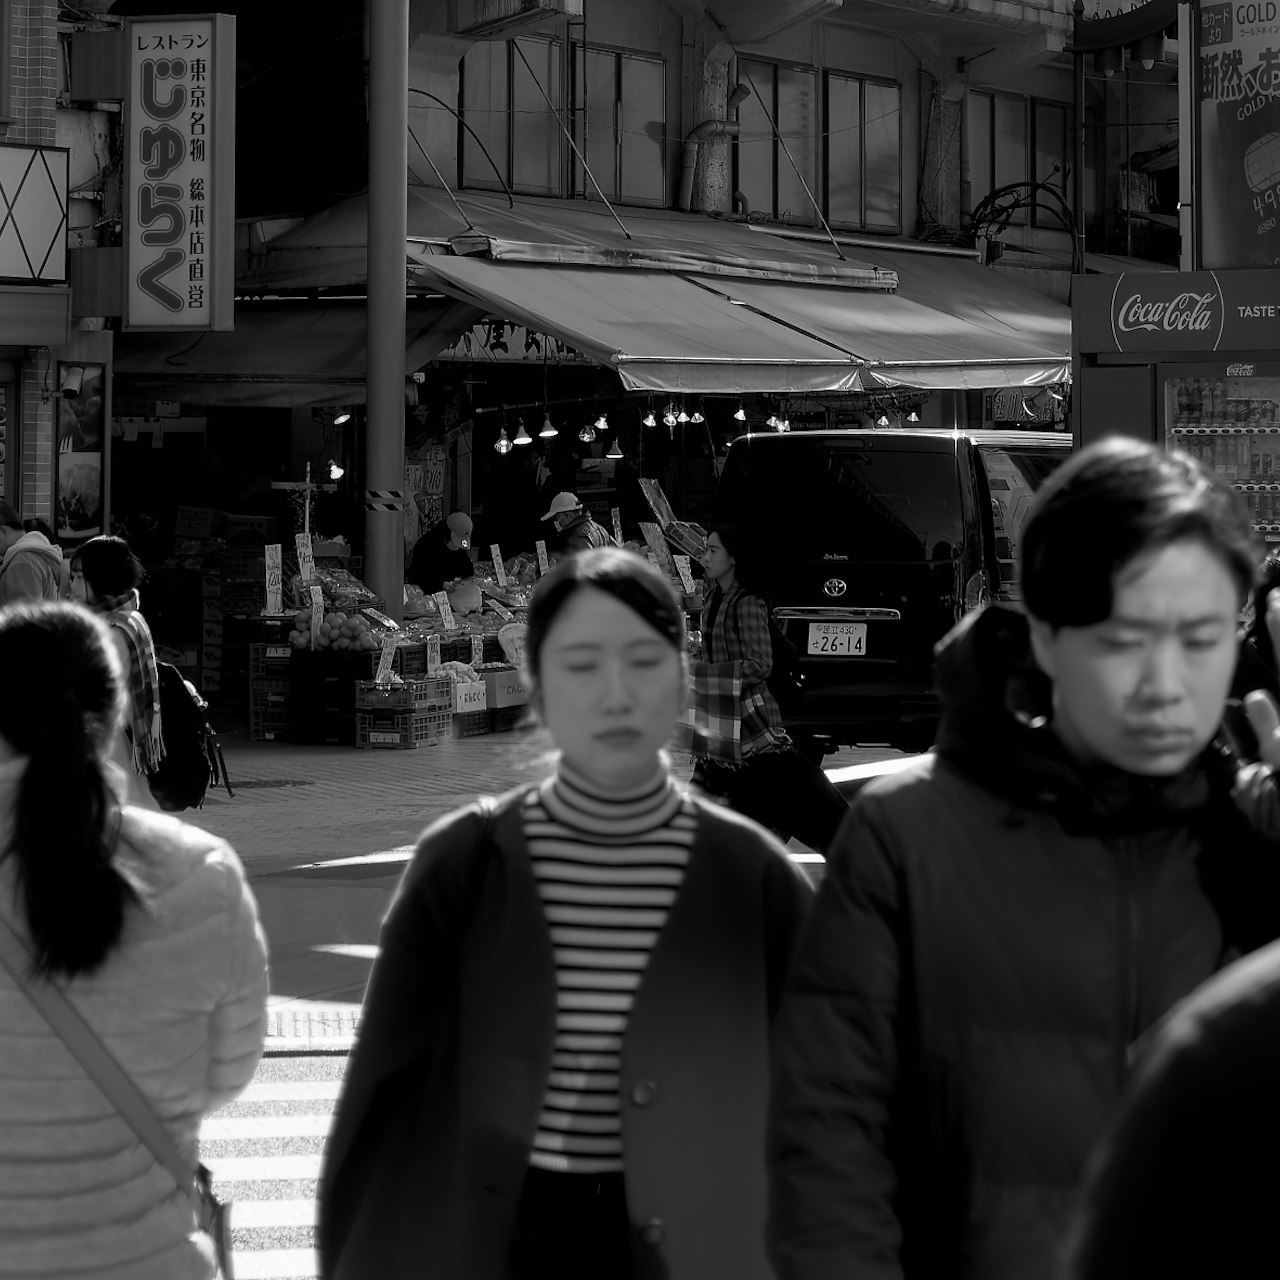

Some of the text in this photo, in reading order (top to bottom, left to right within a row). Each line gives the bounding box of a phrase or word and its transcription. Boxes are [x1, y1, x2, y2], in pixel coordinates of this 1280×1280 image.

[1236, 1, 1277, 25] GOLD
[136, 32, 210, 51] レストラン
[138, 56, 188, 314] じゅらく
[187, 57, 208, 310] 東京名物 総本店直営
[1118, 292, 1218, 333] Coca-Cola
[1237, 305, 1275, 318] TASTE
[820, 635, 863, 653] 26-14
